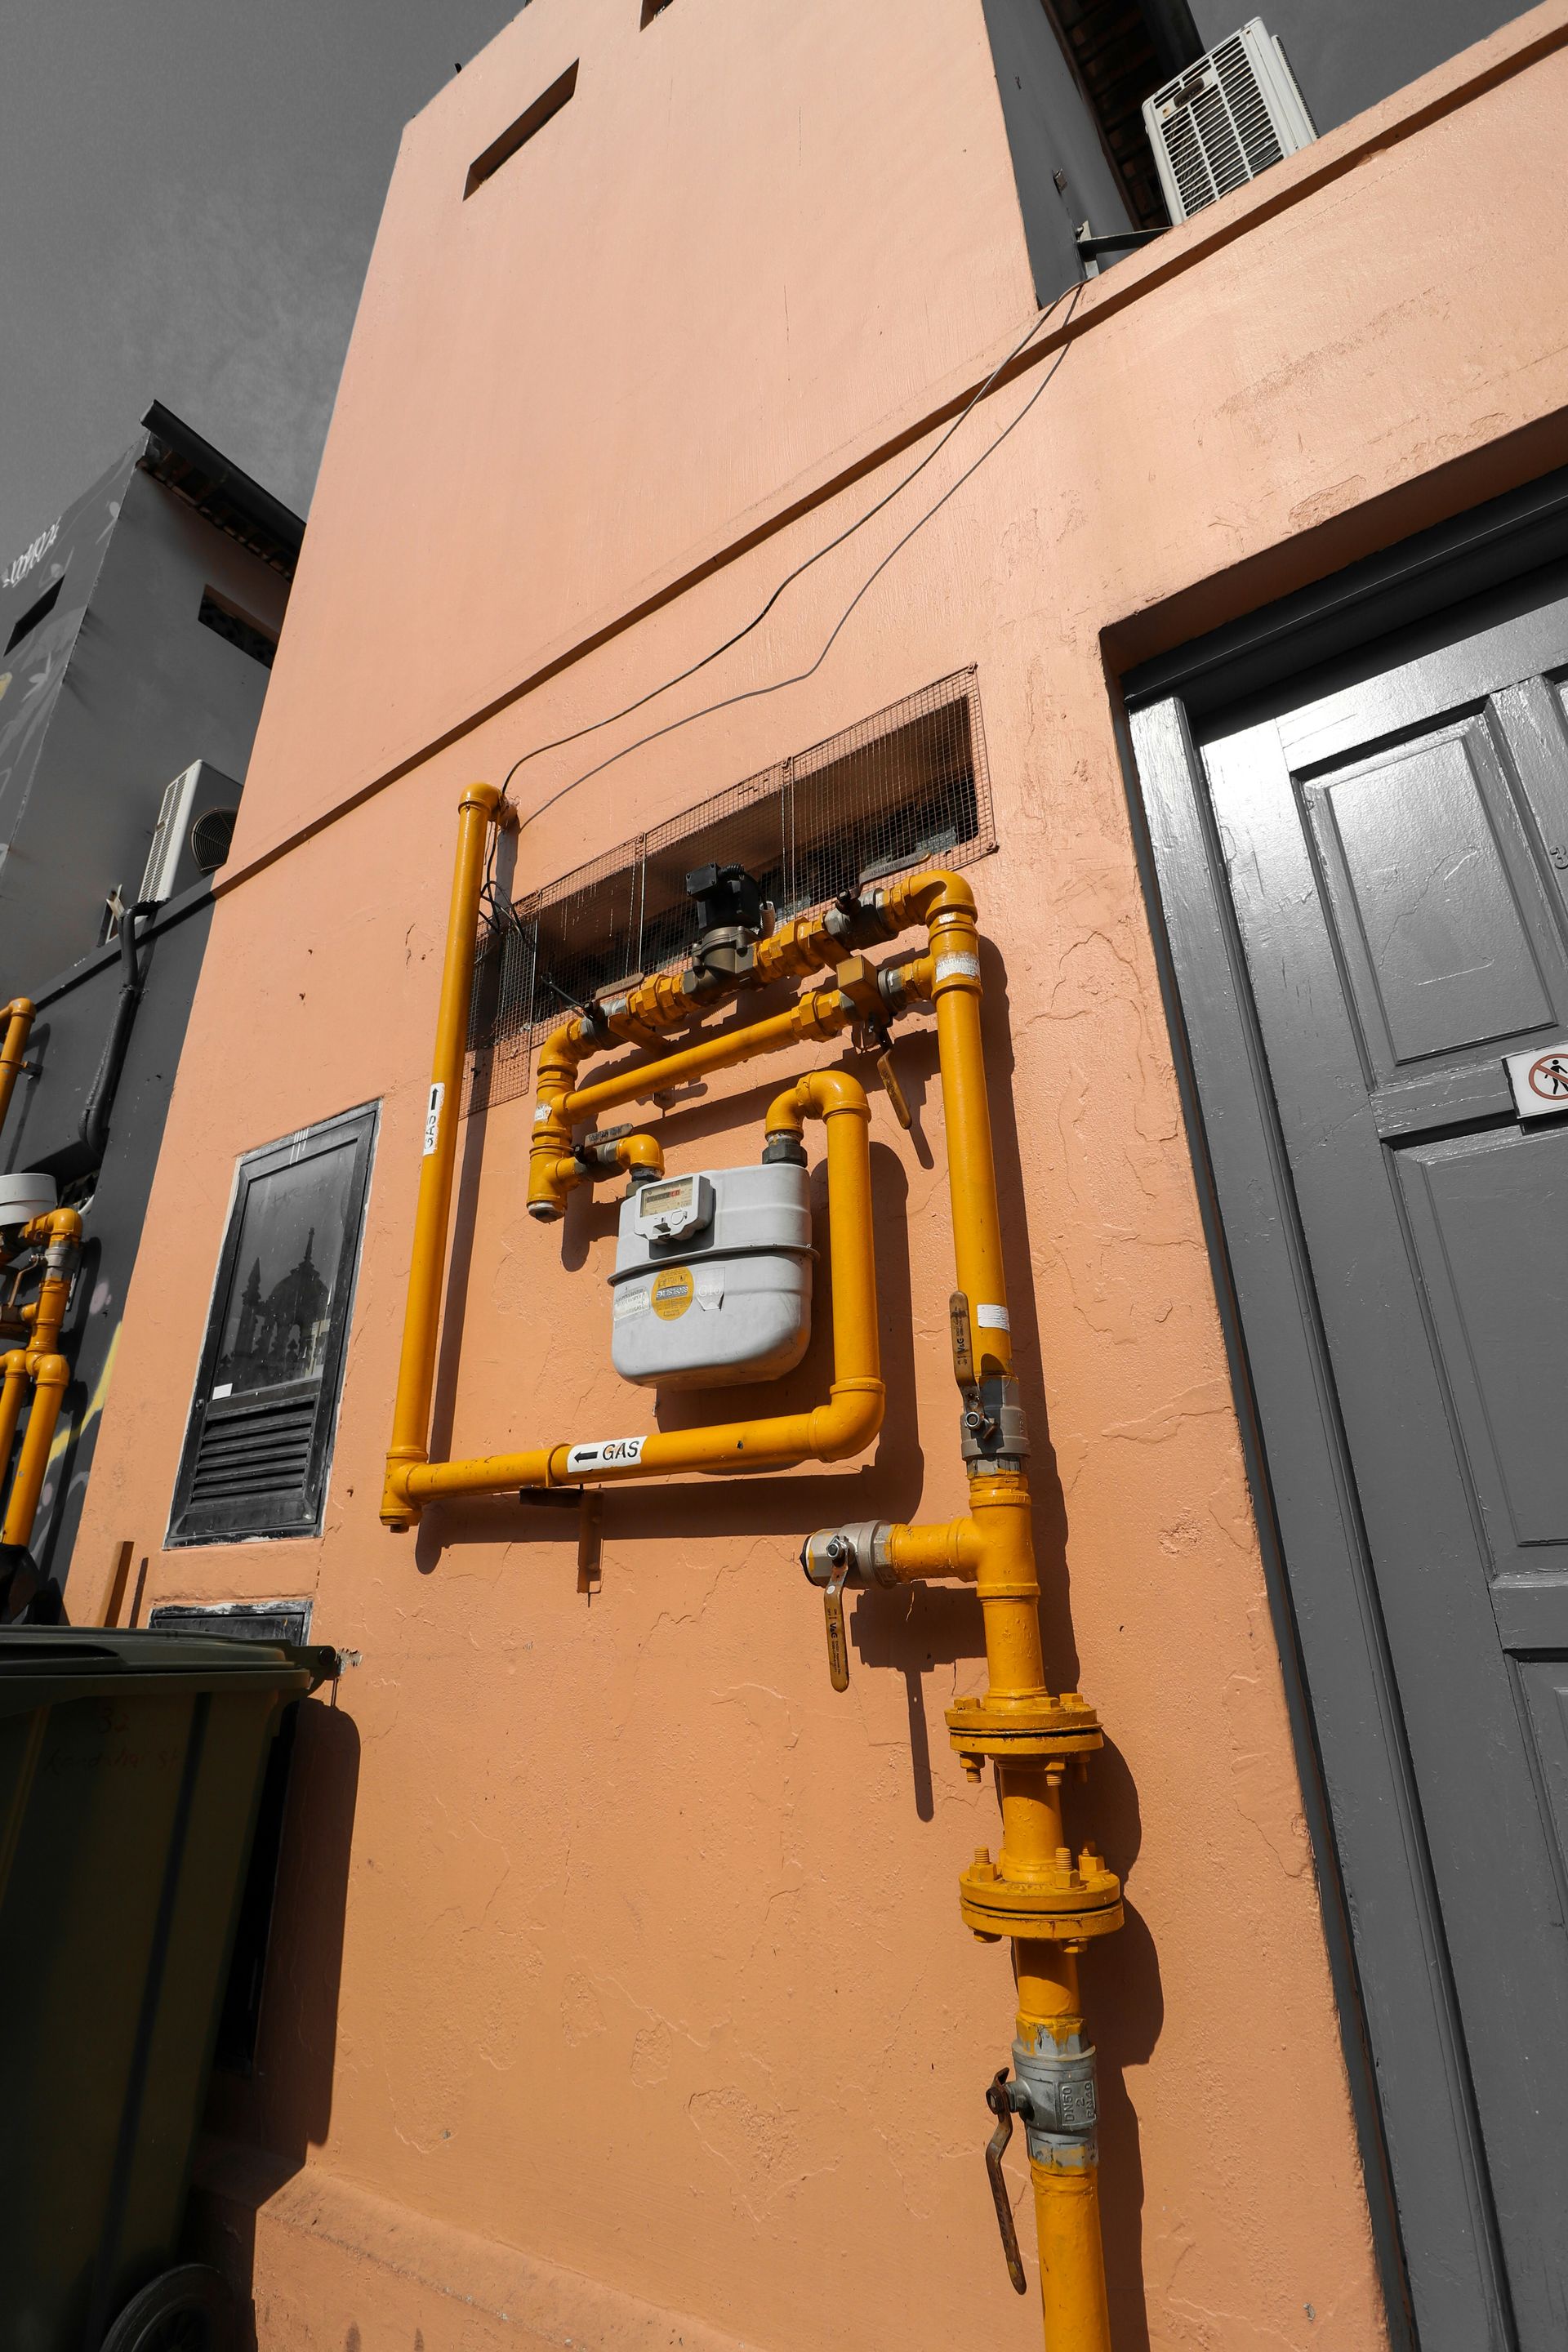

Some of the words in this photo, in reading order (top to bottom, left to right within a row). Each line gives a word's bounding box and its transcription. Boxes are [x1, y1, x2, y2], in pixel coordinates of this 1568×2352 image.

[424, 1115, 436, 1150] GAS
[603, 1441, 639, 1461] GAS
[830, 1622, 838, 1639] V&G
[1062, 2086, 1075, 2122] DN50
[1075, 2096, 1085, 2107] 2
